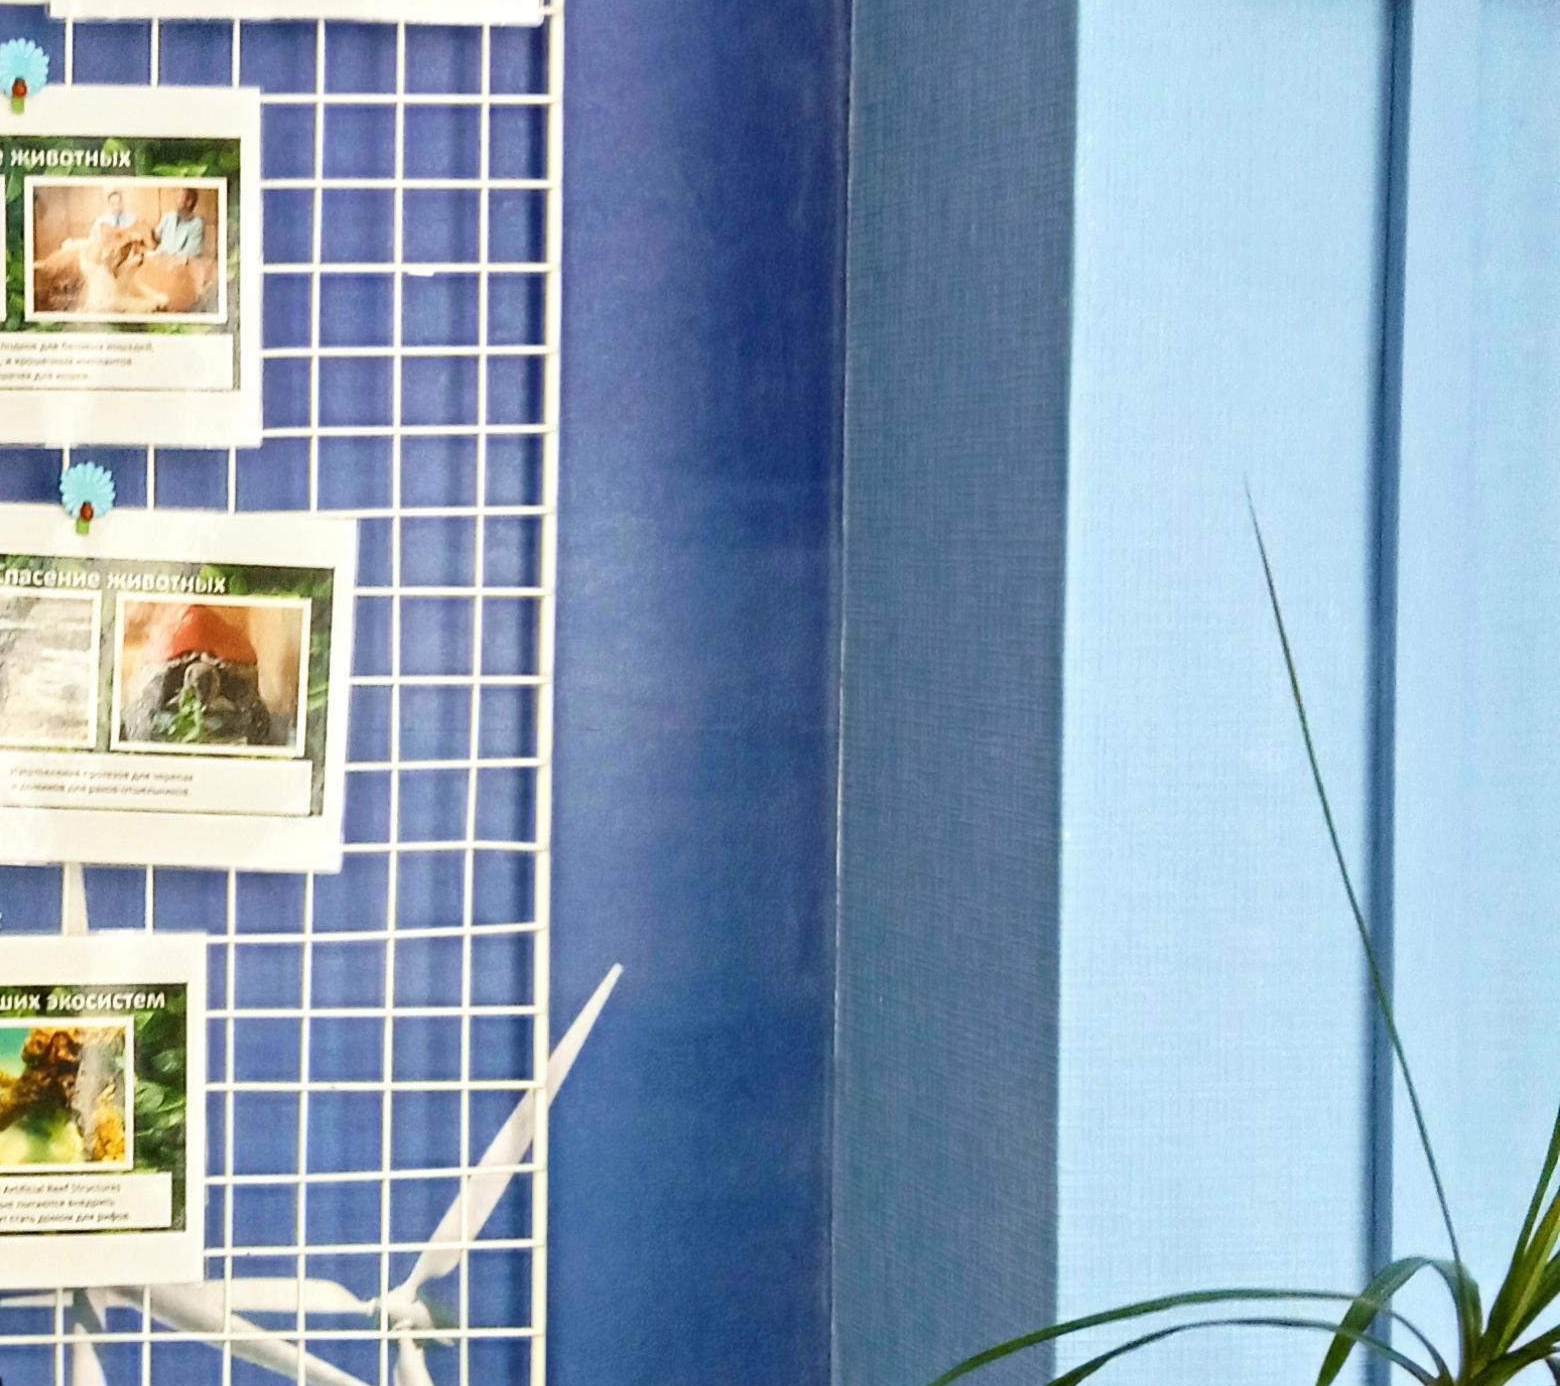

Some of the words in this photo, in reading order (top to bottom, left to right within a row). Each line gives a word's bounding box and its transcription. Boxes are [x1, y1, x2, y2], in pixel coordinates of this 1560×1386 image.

[10, 146, 132, 169] животных
[105, 570, 227, 595] животных
[45, 989, 166, 1011] экосистем
